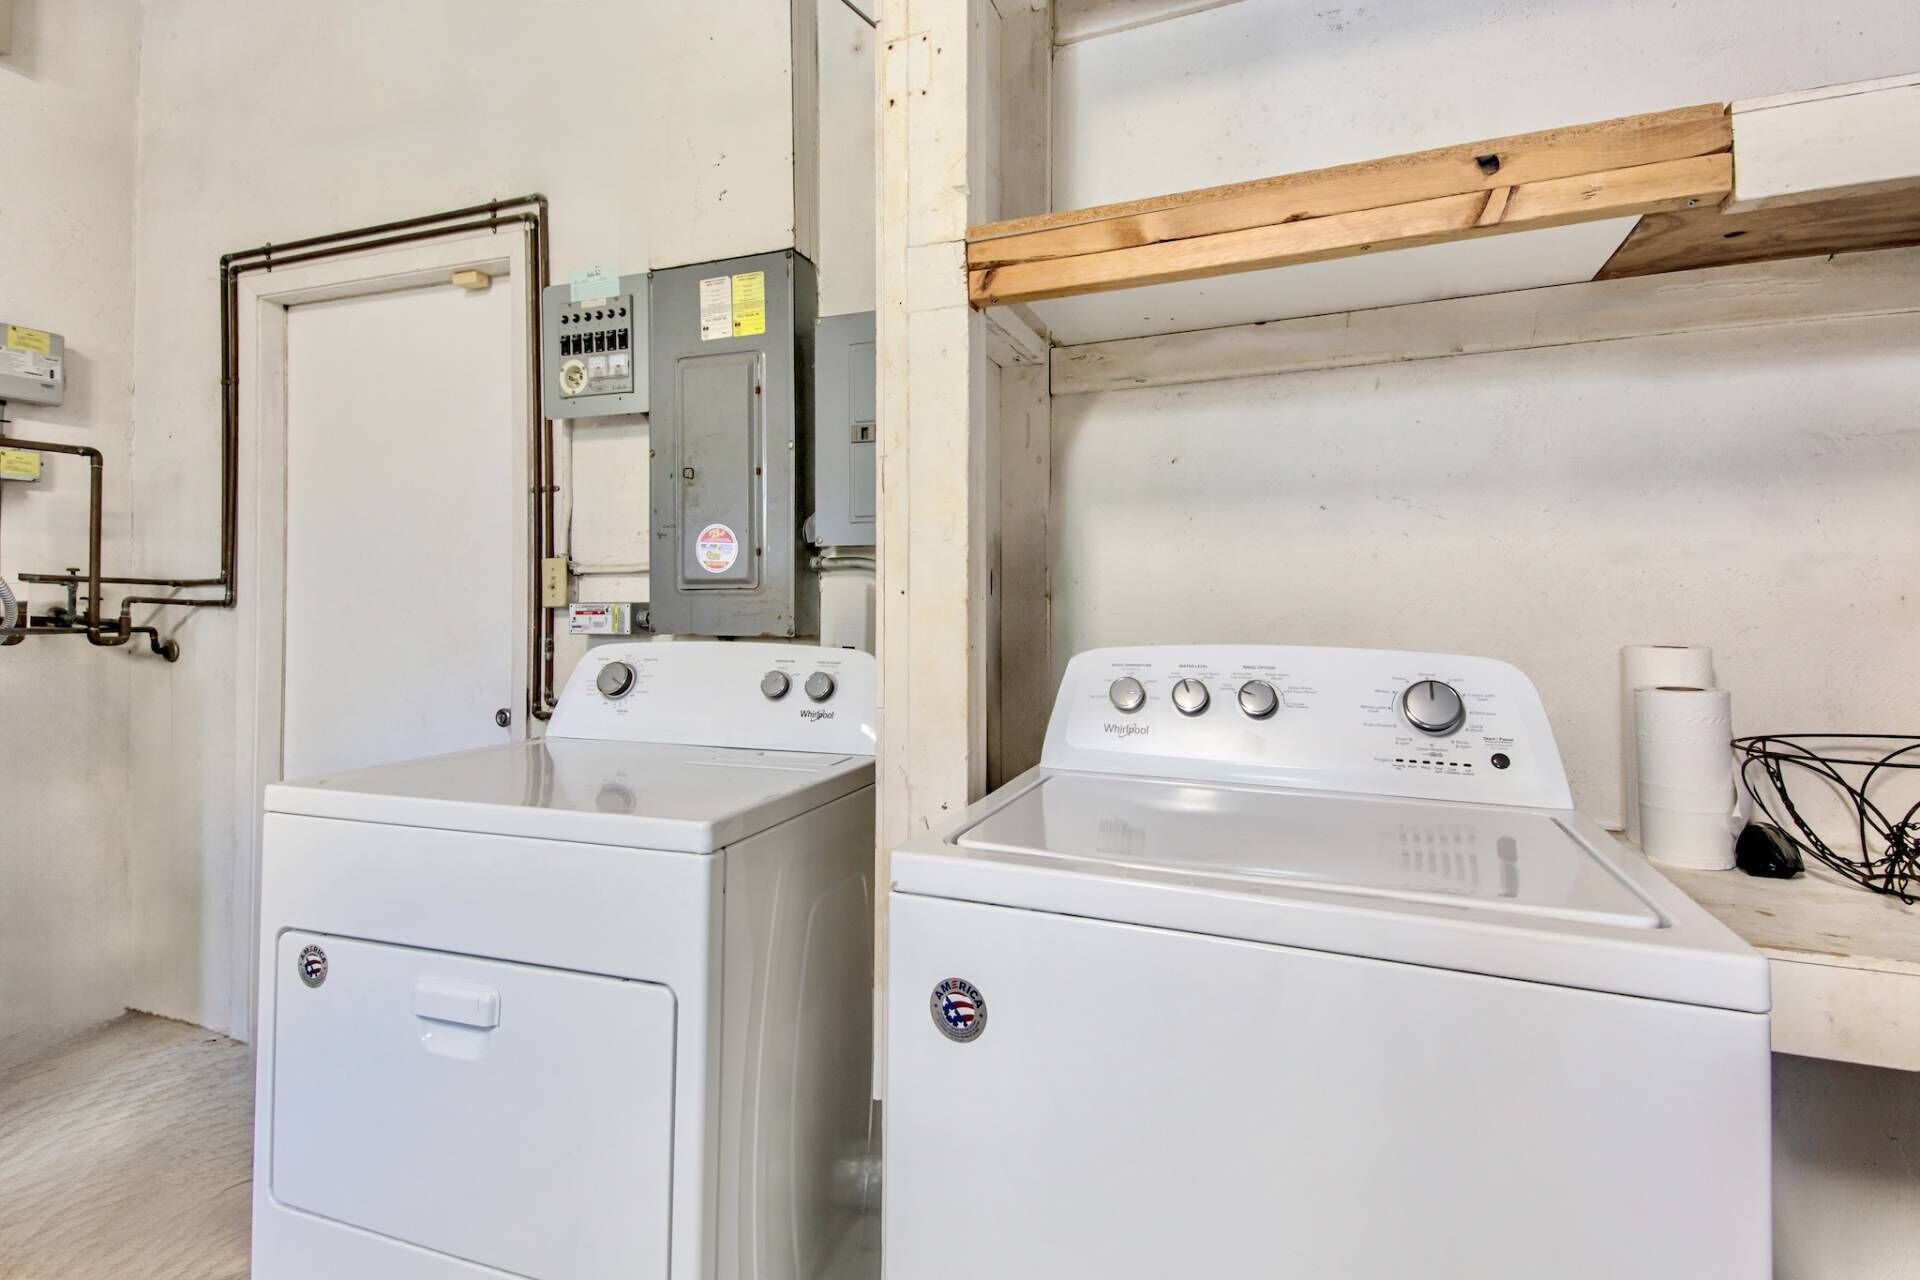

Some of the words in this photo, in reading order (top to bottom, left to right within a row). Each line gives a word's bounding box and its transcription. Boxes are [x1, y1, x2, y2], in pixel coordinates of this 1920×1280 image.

[800, 709, 835, 723] Whirlpool
[1103, 723, 1150, 738] Whirlpool
[300, 945, 327, 964] AMERICA
[934, 979, 983, 1009] AMERICA
